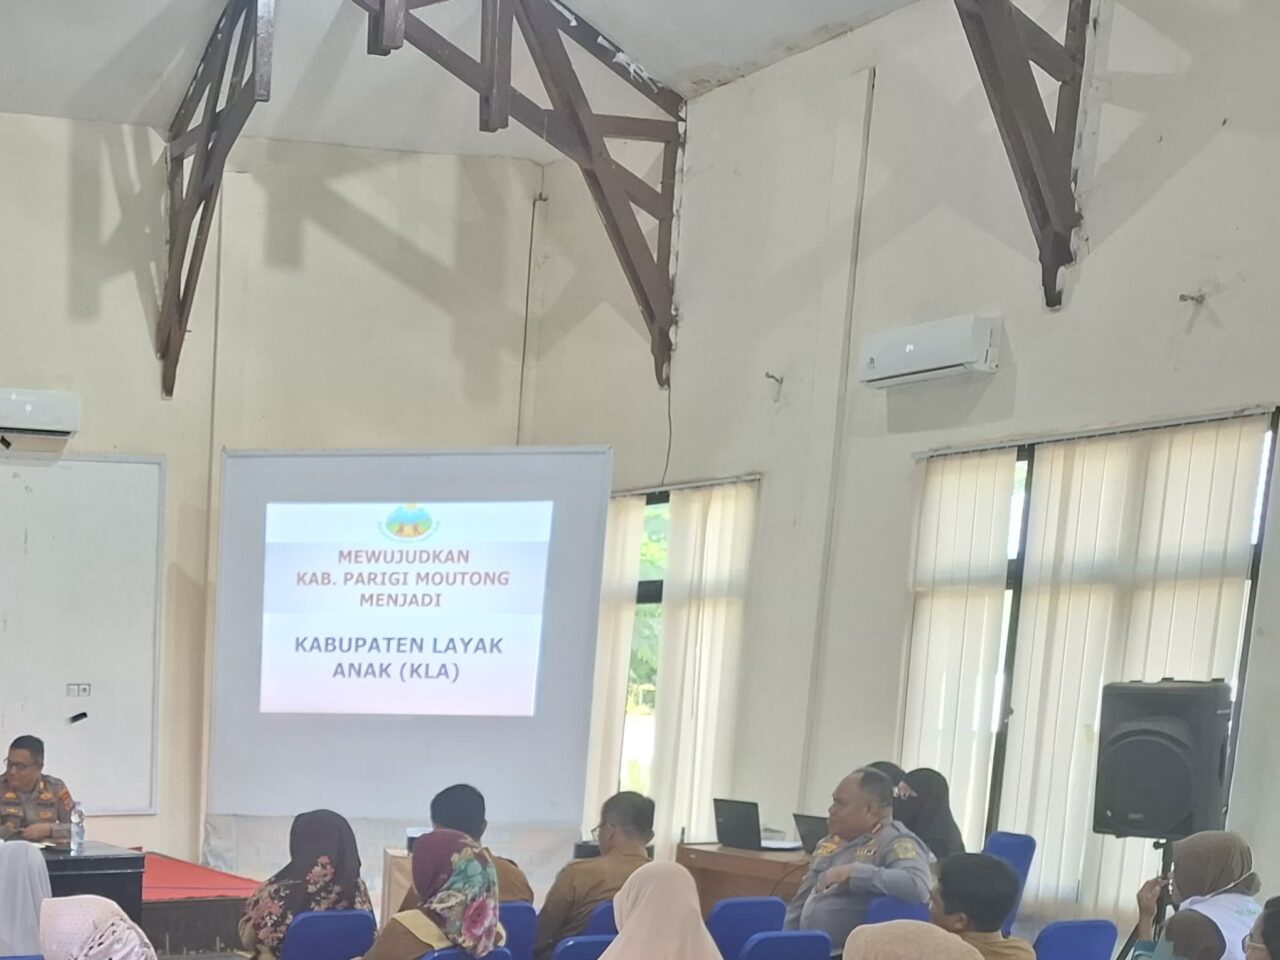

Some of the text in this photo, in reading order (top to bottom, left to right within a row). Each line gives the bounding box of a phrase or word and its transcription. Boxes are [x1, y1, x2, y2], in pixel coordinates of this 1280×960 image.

[337, 549, 470, 565] MEWUJUDKAN
[296, 571, 510, 587] KAB. PARIGI MOUTONG
[359, 592, 443, 608] MENJADI
[294, 636, 504, 655] KABUPATEN LAYAK
[332, 662, 460, 684] ANAK (KLA)
